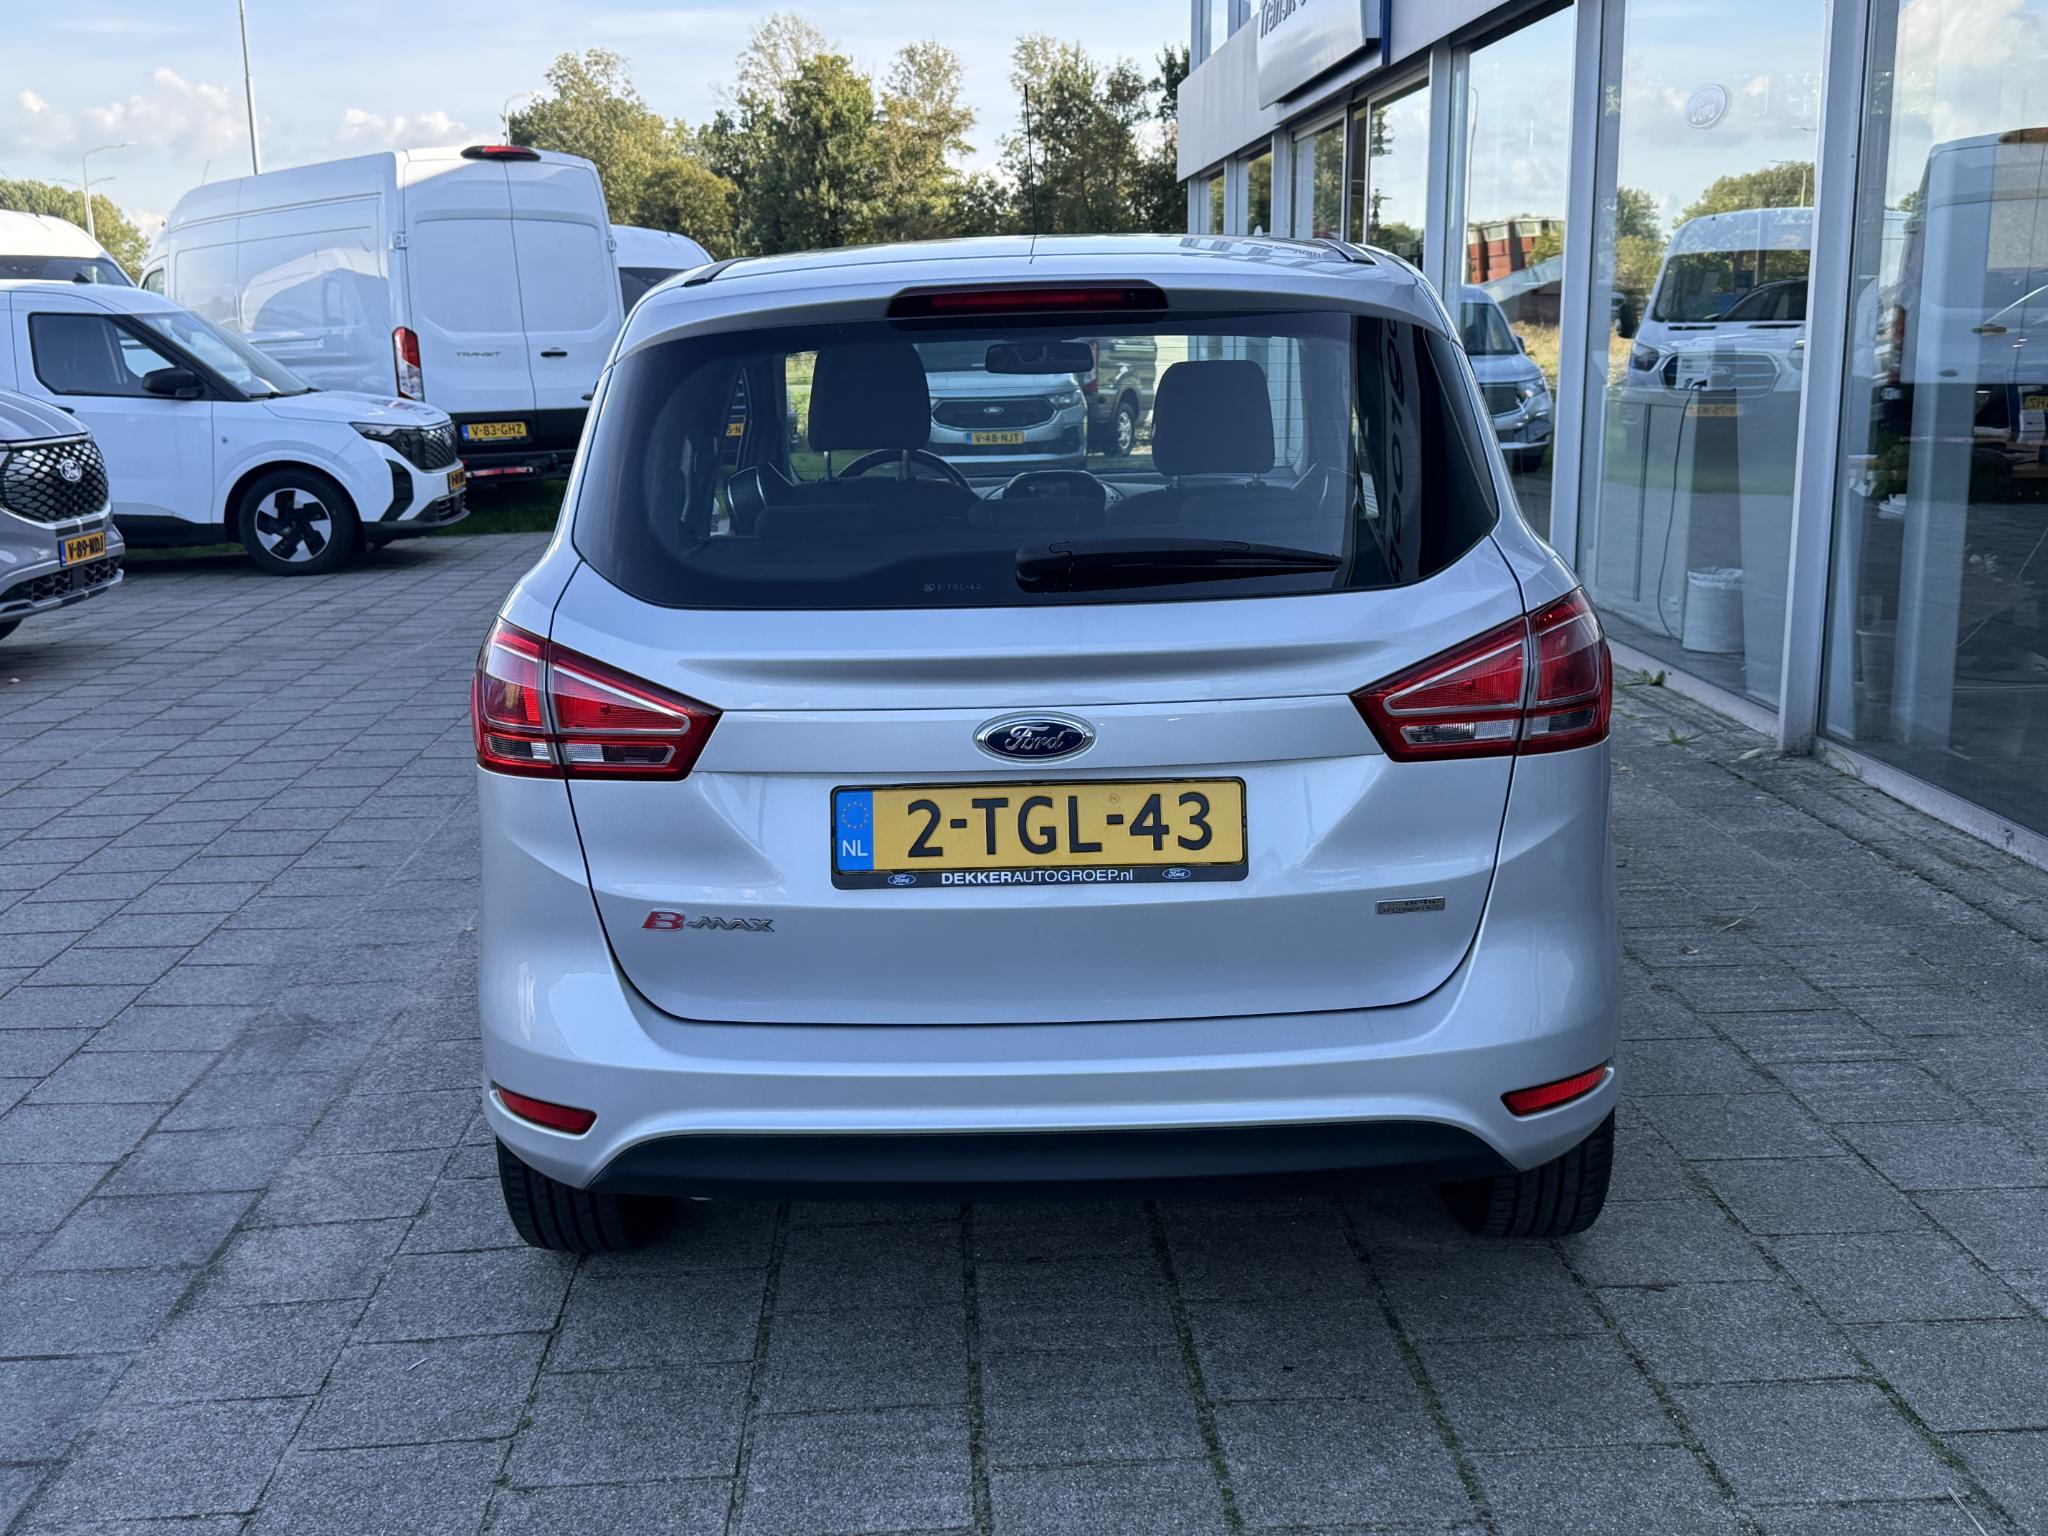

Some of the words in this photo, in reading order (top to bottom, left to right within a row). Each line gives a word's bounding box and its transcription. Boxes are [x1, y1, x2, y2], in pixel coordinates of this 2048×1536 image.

[471, 423, 523, 436] V-83-GHZ
[1004, 725, 1066, 750] Ford
[907, 791, 1213, 857] 2-TGL-43
[842, 839, 868, 857] NL
[941, 869, 1133, 885] DEKKERAUTOGROEP.nl
[642, 908, 776, 932] B-MAX
